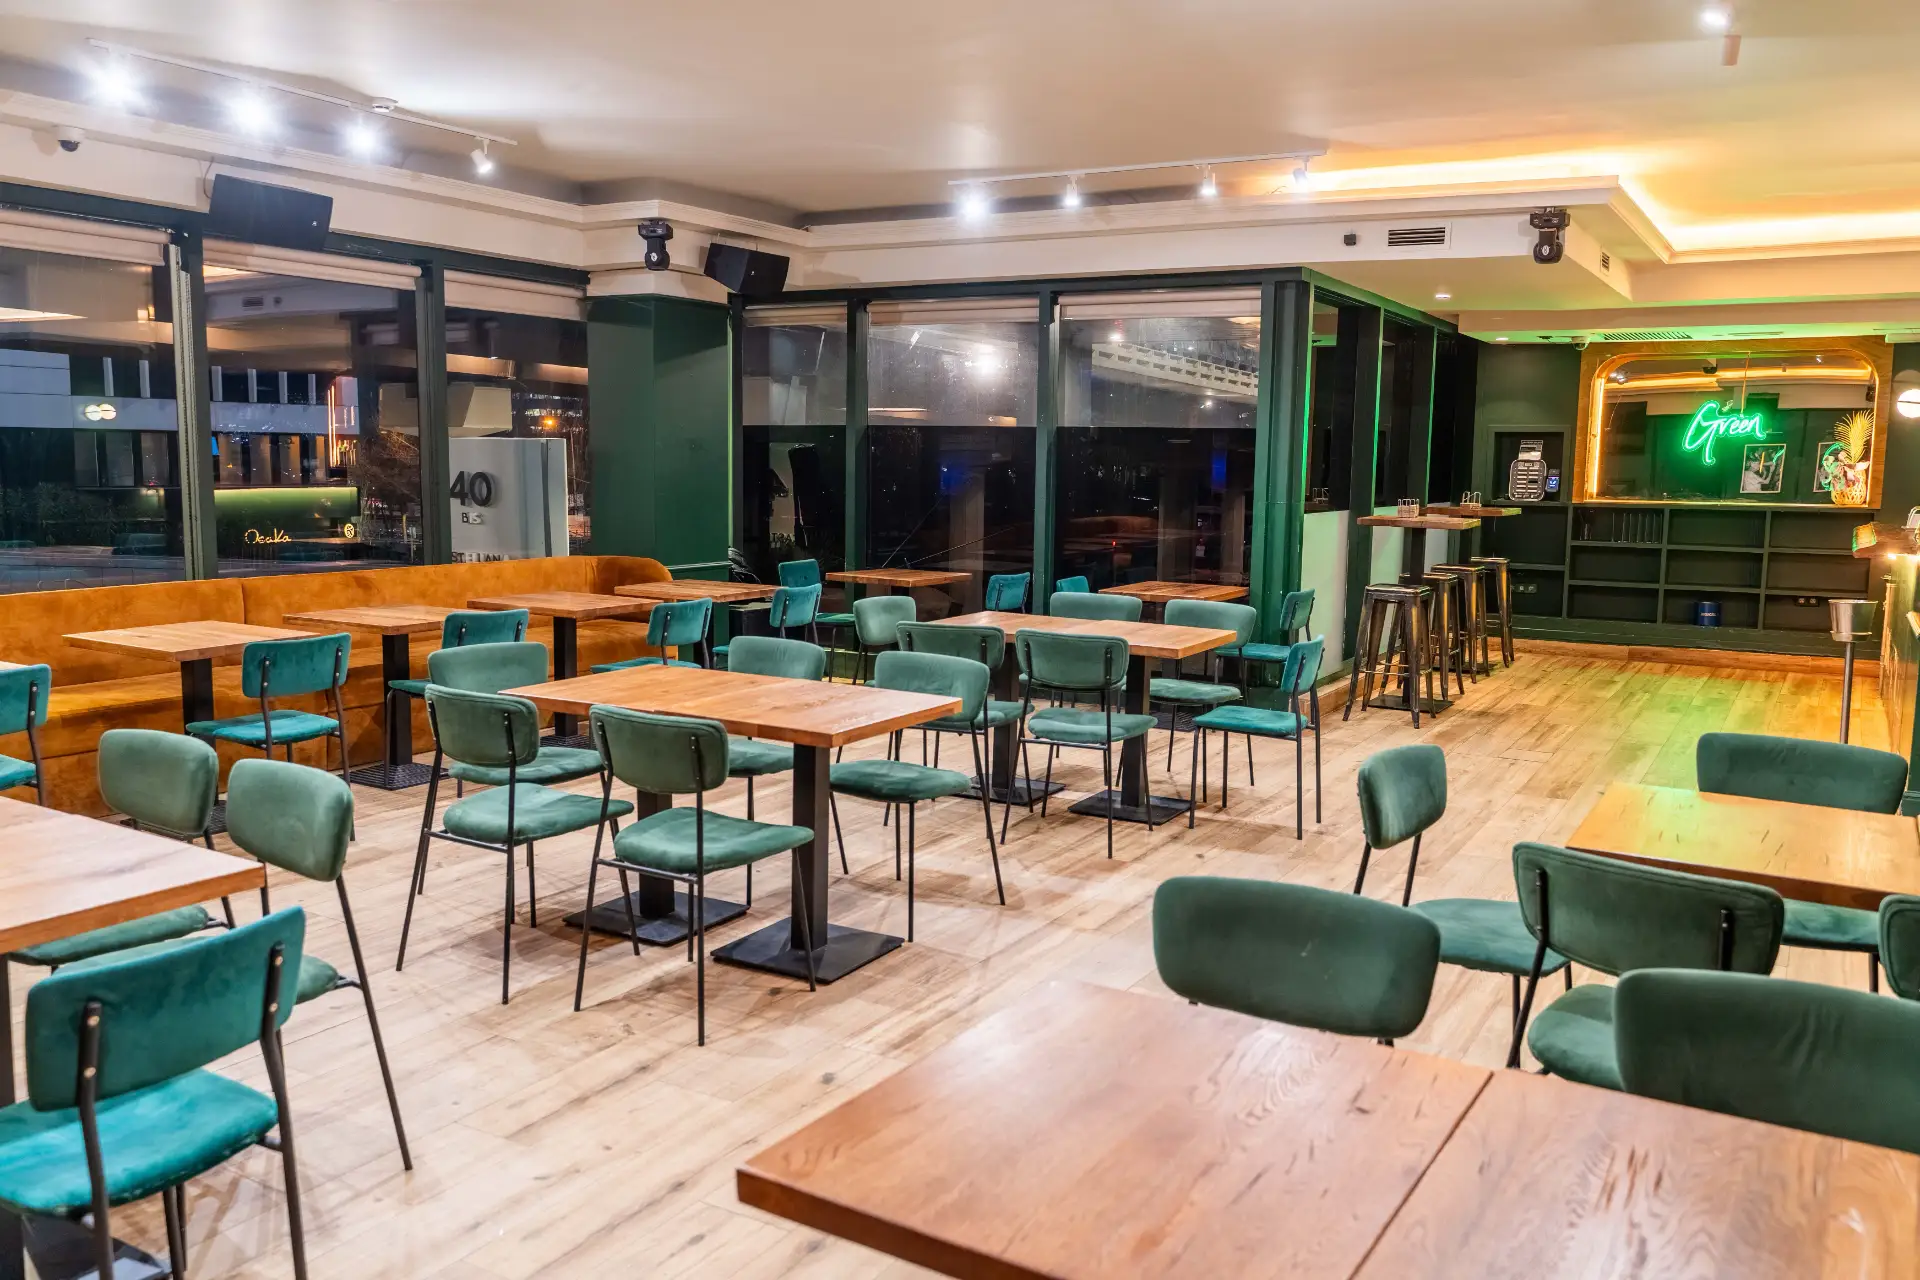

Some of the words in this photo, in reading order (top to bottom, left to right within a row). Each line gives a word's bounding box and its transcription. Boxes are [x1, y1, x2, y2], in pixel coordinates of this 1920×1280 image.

[1683, 401, 1766, 465] Green
[450, 470, 493, 507] 40
[461, 512, 482, 525] BIS
